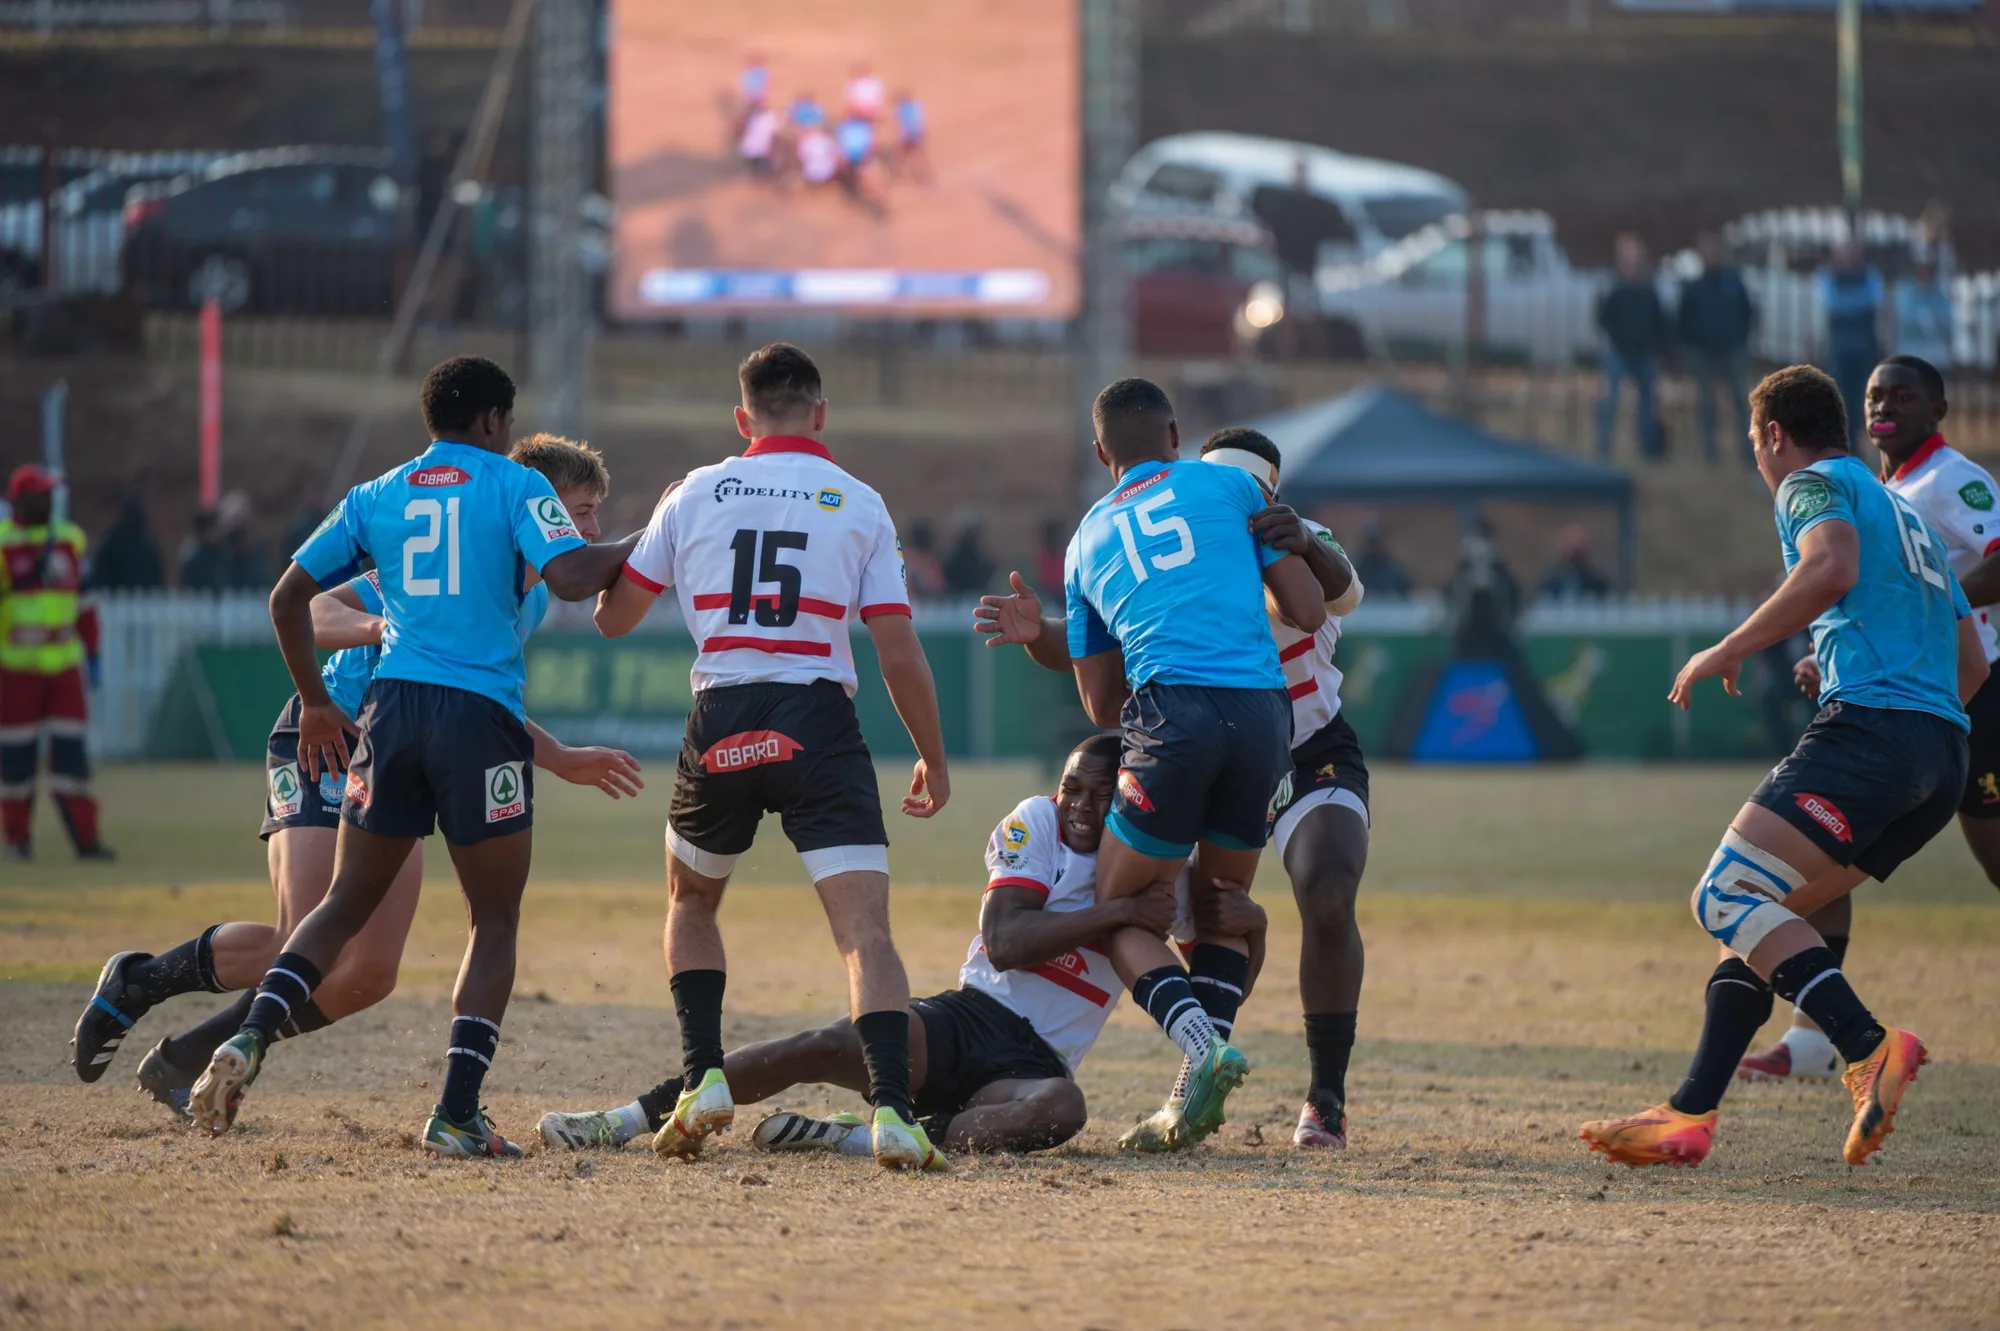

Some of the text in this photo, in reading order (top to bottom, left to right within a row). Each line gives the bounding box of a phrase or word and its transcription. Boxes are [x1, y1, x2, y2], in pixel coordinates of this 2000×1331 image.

[418, 471, 459, 485] OBARO
[1121, 473, 1161, 500] OBARO
[722, 486, 841, 506] FIDELITY ADT
[403, 497, 460, 596] 21
[1112, 488, 1196, 584] 15
[1883, 488, 1946, 590] 12
[728, 528, 808, 627] 15
[715, 738, 779, 768] OBARO
[491, 803, 521, 820] SPAR
[1804, 798, 1845, 834] OBARO
